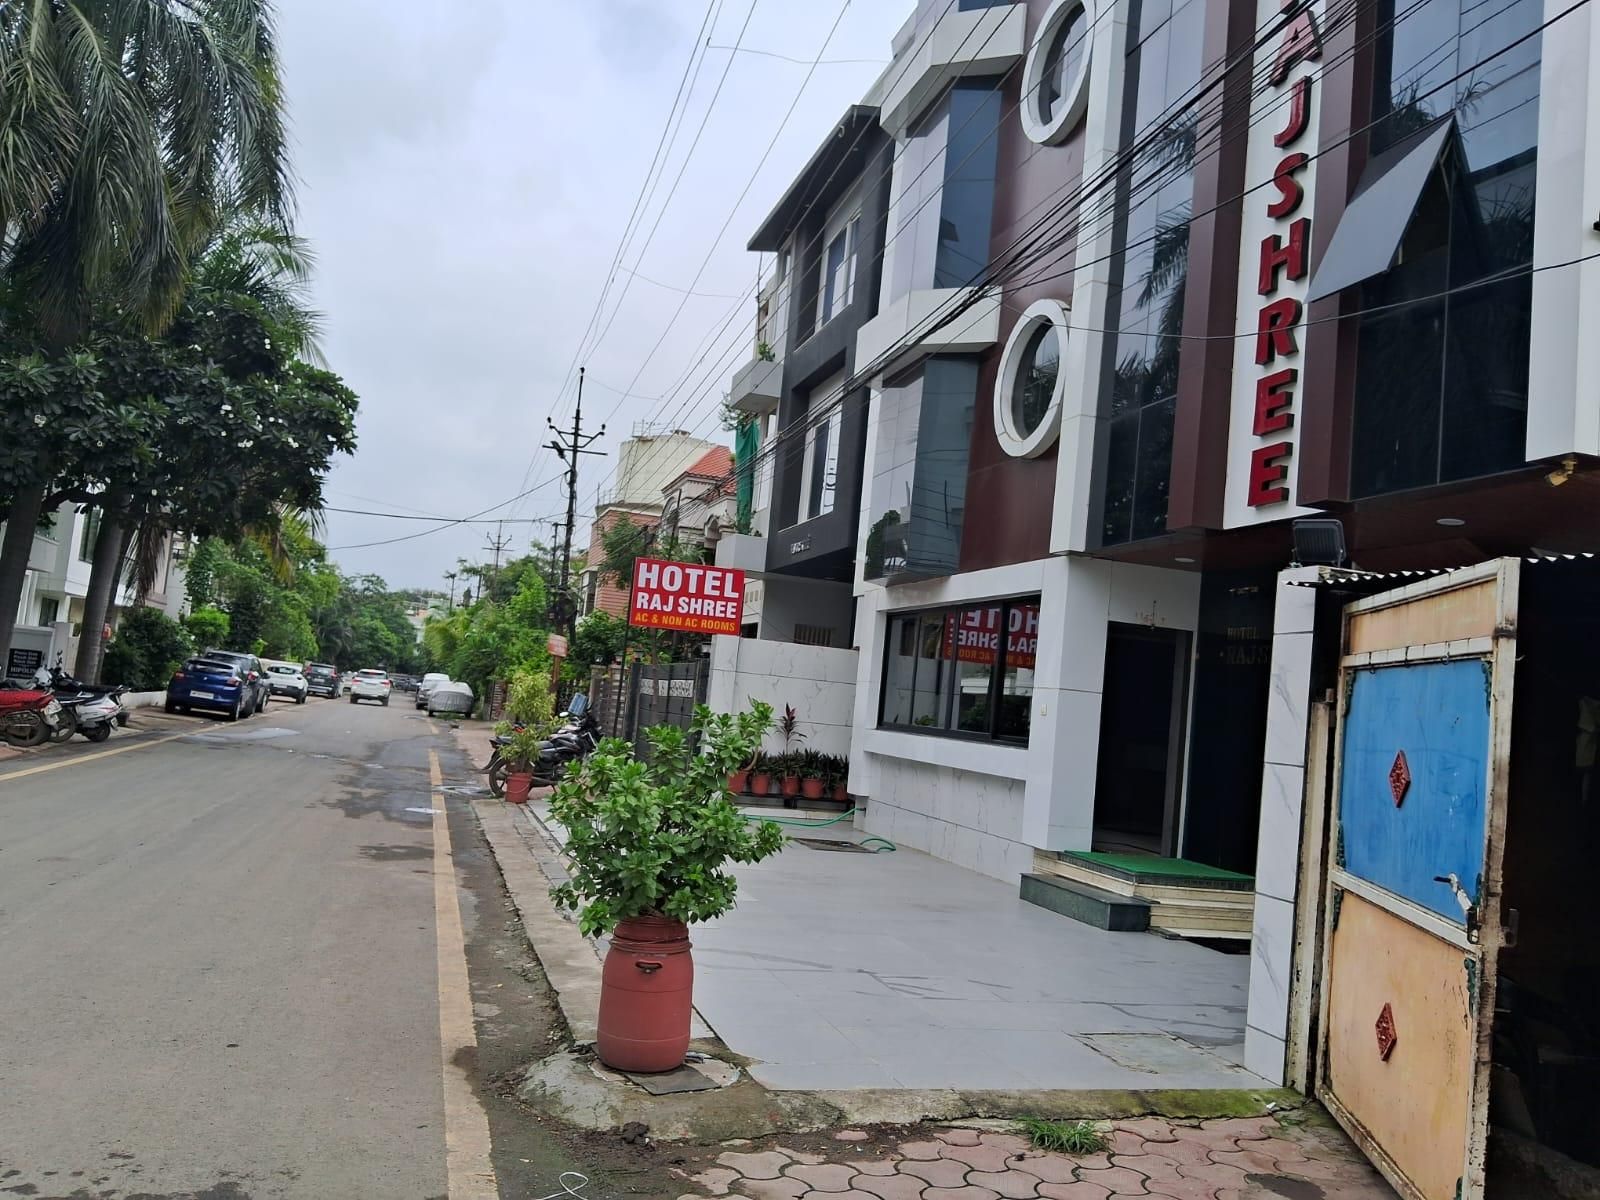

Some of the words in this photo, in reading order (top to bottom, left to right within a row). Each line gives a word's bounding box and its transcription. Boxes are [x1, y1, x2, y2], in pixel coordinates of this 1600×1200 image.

[1247, 0, 1323, 508] AJSHREE
[638, 562, 739, 598] HOTEL
[636, 591, 674, 612] RAJ
[677, 597, 737, 619] SHREE
[635, 612, 648, 624] AC
[651, 613, 660, 624] &
[662, 614, 682, 626] NON
[685, 617, 698, 628] AC
[701, 619, 736, 632] ROOMS
